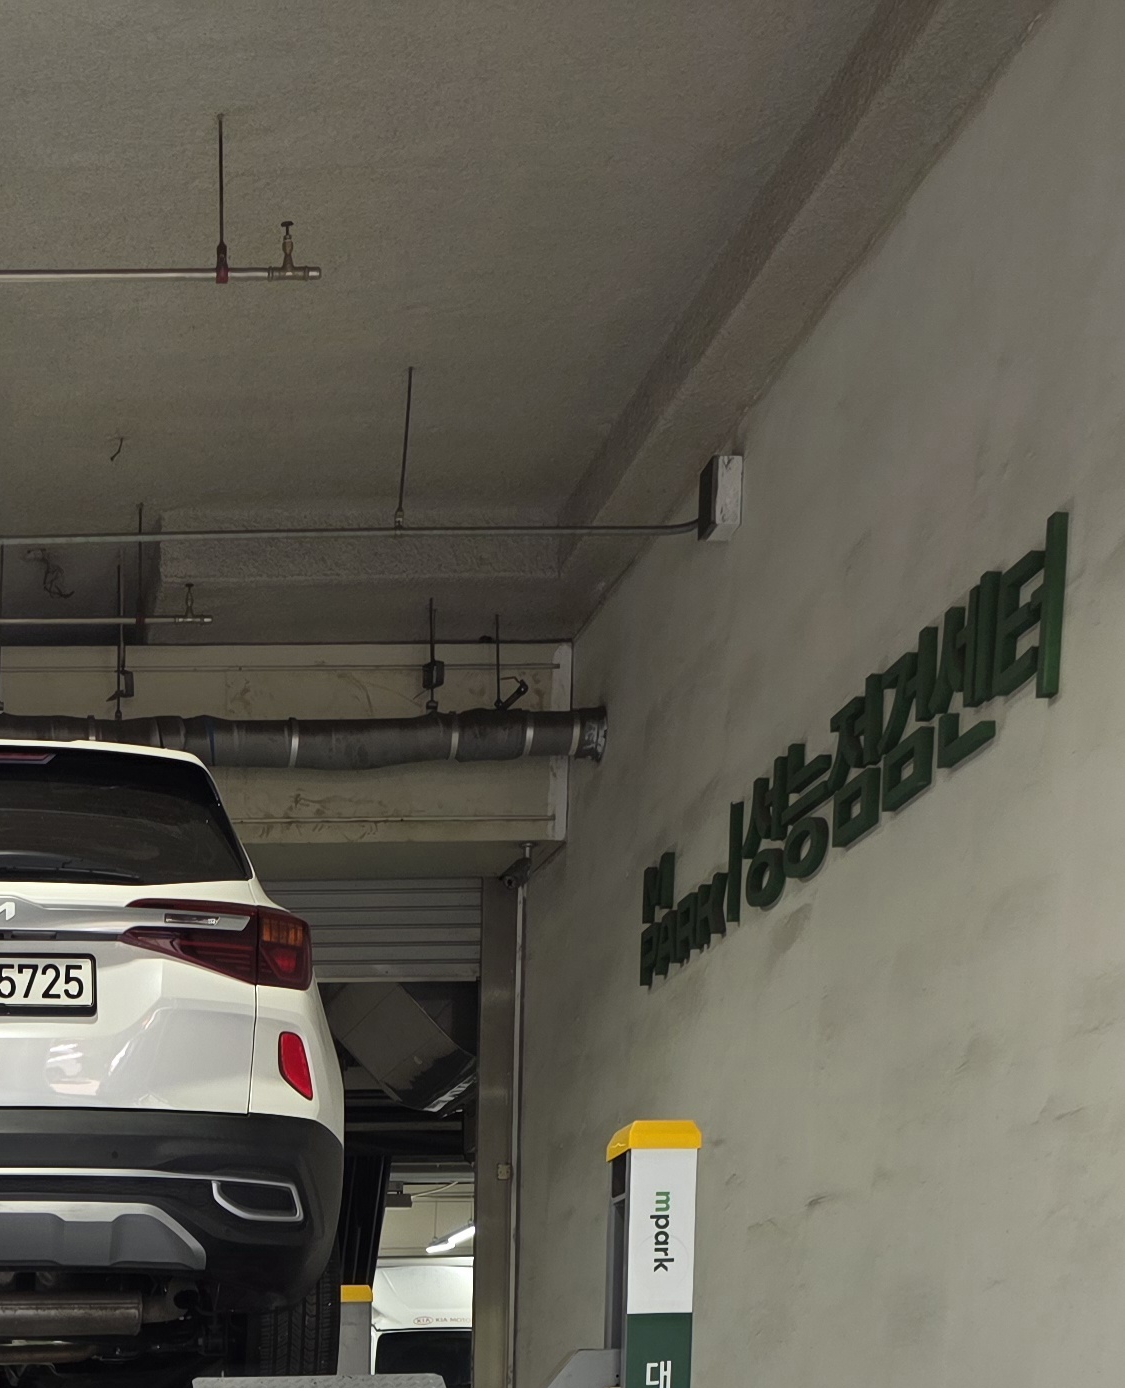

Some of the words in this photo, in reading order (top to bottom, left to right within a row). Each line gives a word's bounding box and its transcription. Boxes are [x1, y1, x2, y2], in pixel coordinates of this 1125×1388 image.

[742, 511, 1069, 908] 성능점검센터
[640, 872, 728, 986] PARK
[642, 852, 675, 924] M
[650, 1191, 675, 1272] mpark
